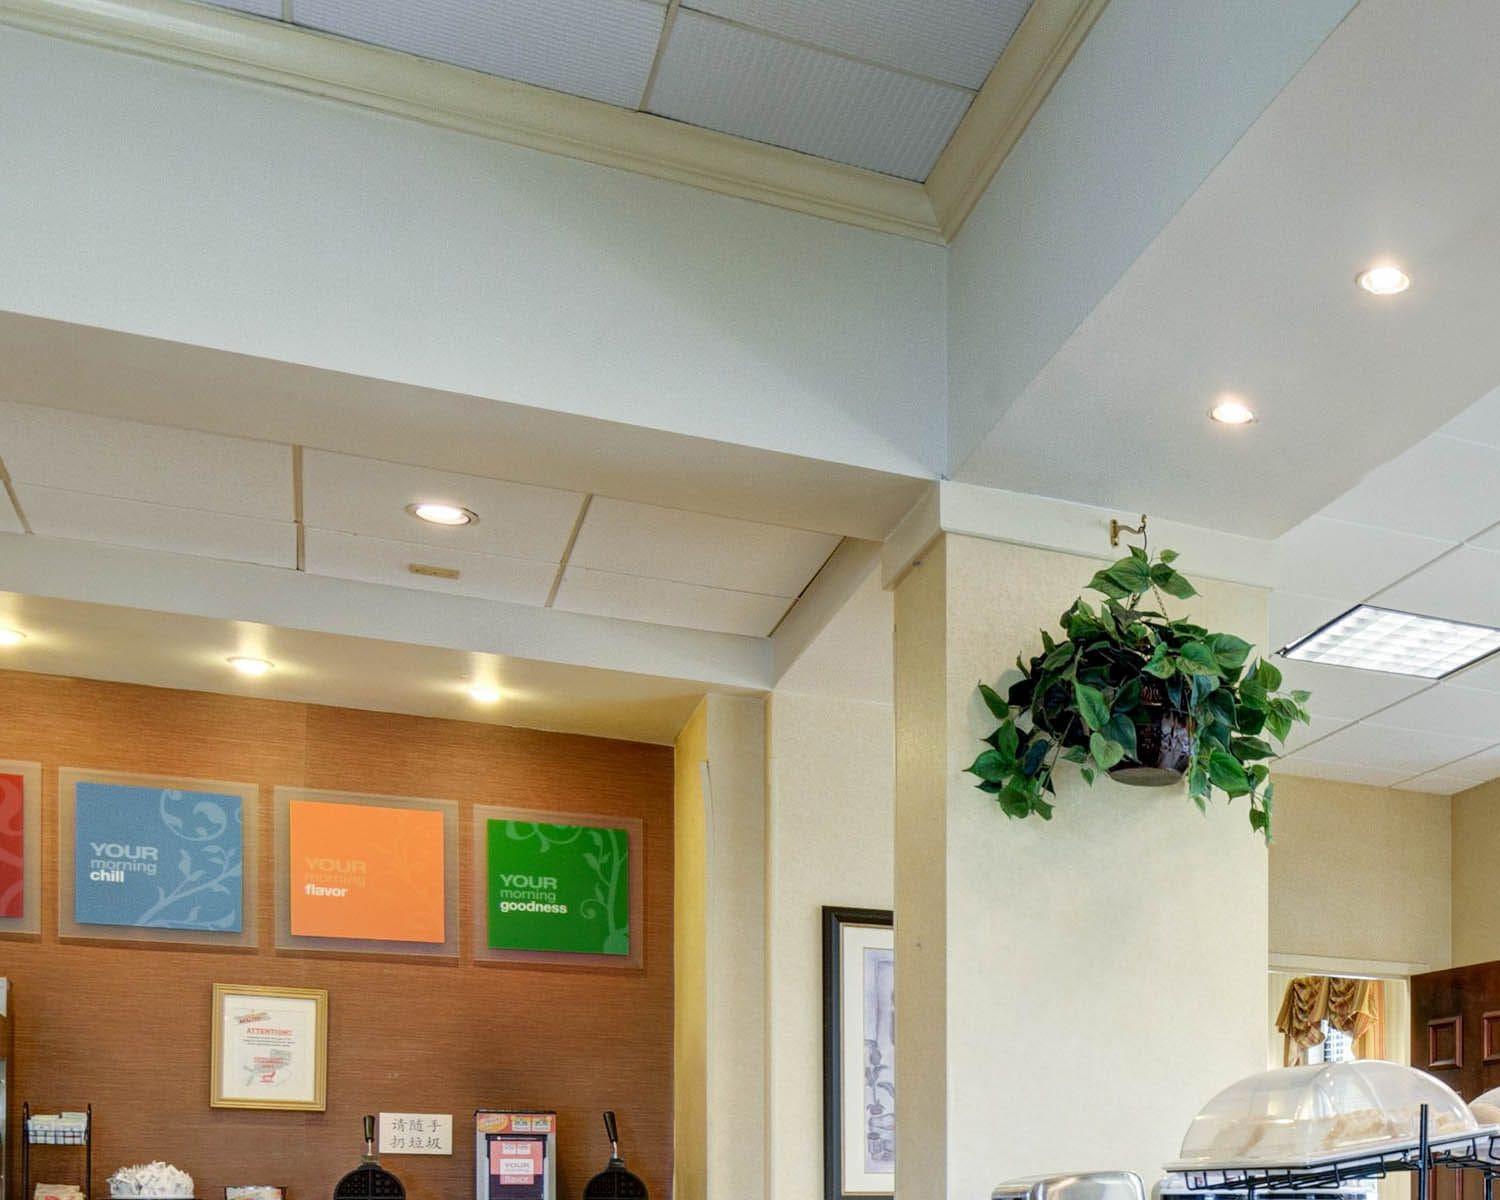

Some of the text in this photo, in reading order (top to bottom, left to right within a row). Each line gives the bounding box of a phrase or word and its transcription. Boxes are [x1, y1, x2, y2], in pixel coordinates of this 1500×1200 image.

[90, 842, 159, 860] YOUR
[91, 859, 157, 876] morning
[304, 856, 367, 874] YOUR
[89, 869, 124, 883] chill
[500, 874, 557, 890] YOUR
[305, 883, 348, 897] flavor
[500, 889, 556, 904] morning
[500, 901, 568, 914] goodness
[391, 1118, 442, 1133] 请随手
[390, 1135, 442, 1150] 扔垃圾
